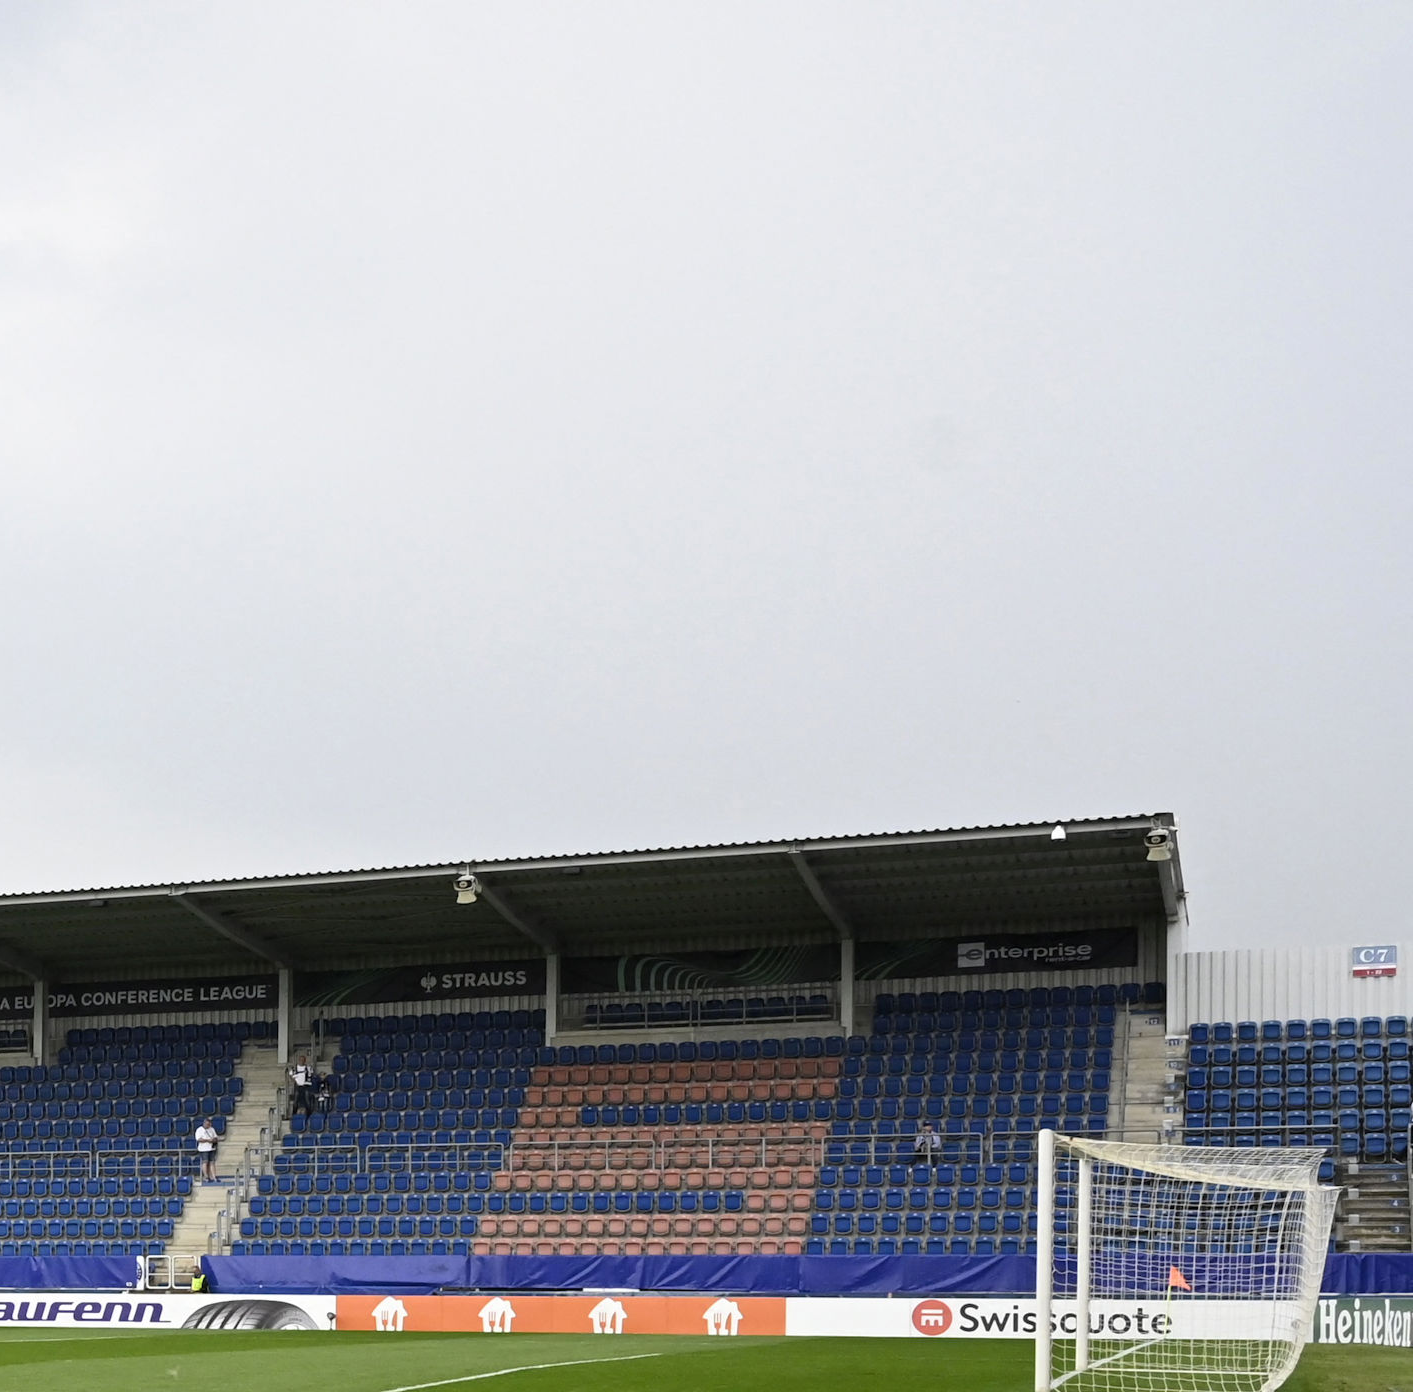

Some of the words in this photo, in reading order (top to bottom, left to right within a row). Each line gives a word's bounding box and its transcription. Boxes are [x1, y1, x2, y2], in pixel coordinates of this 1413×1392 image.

[958, 943, 1092, 961] enterprise
[441, 970, 527, 988] STRAUSS
[14, 994, 77, 1010] EUOPA
[81, 987, 194, 1006] CONFERENCE
[199, 984, 266, 1001] LEAGUE
[1318, 1297, 1412, 1348] Heineken
